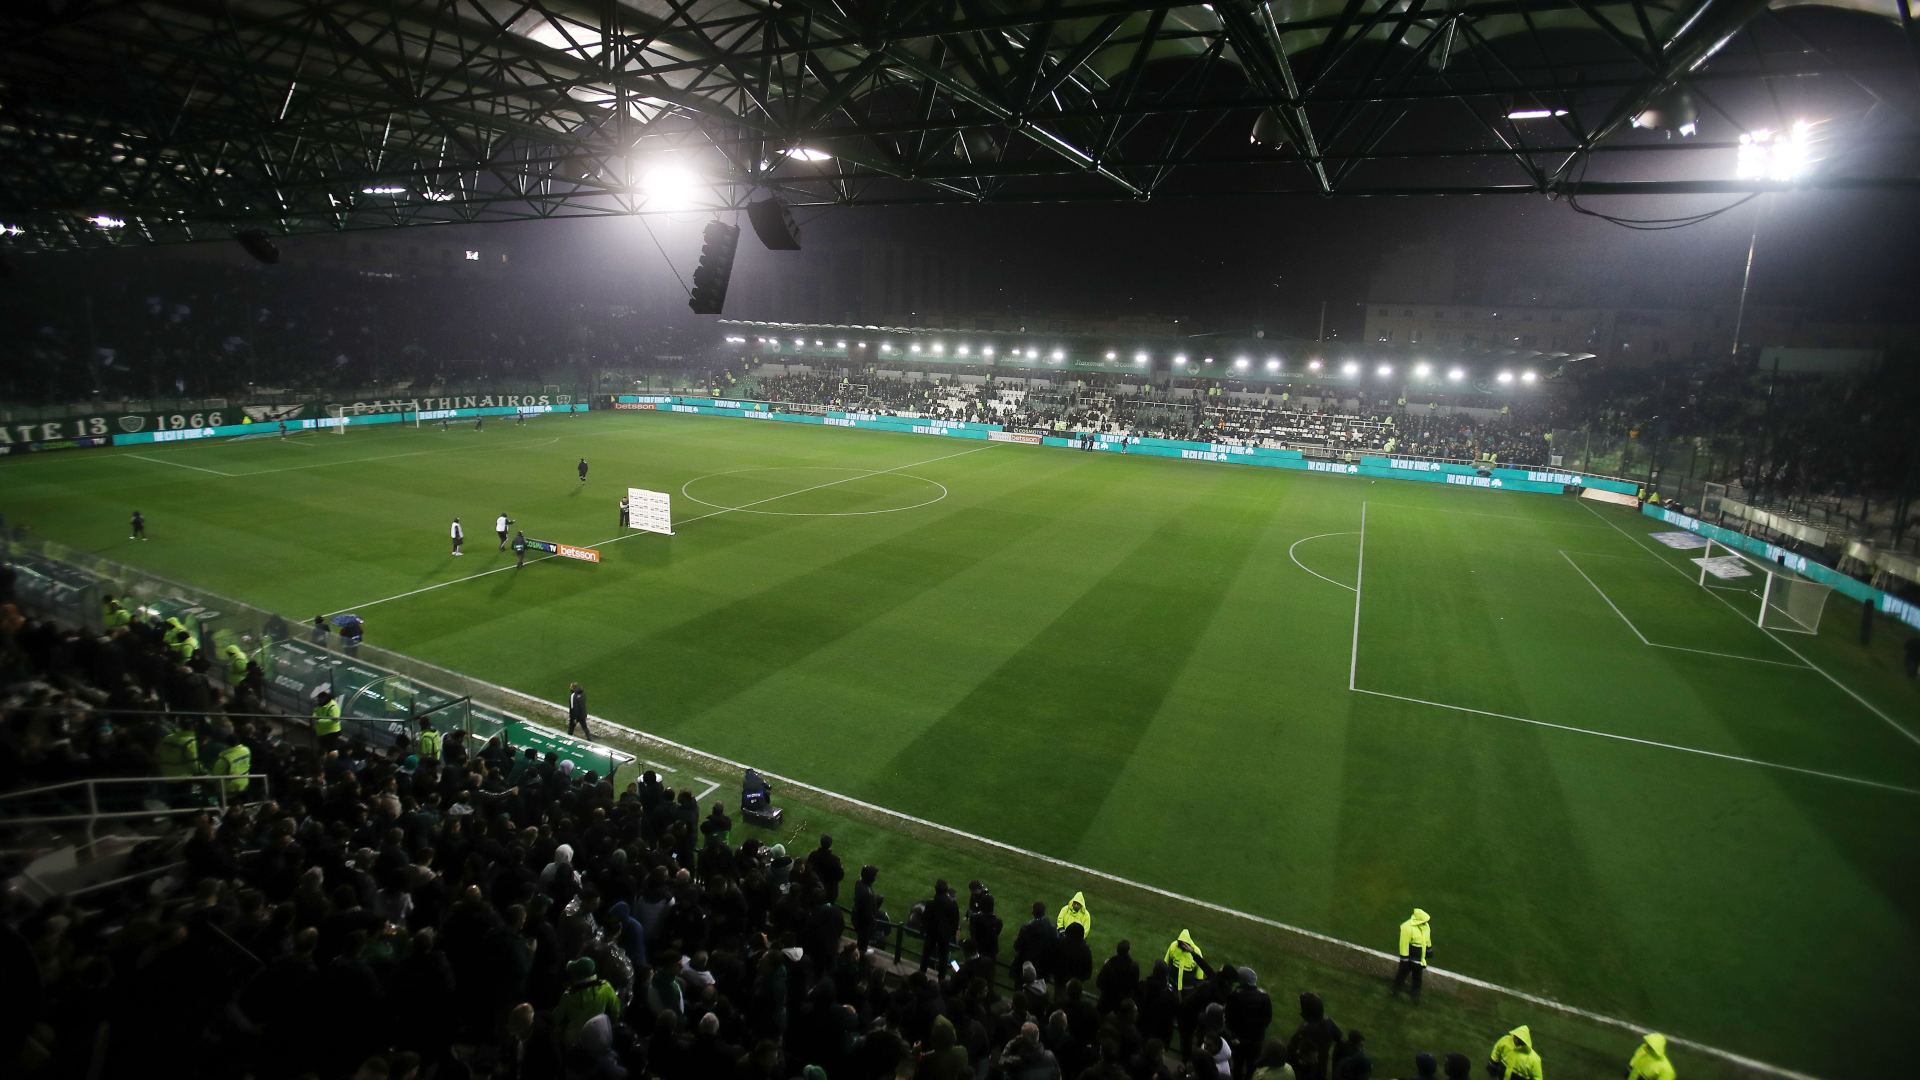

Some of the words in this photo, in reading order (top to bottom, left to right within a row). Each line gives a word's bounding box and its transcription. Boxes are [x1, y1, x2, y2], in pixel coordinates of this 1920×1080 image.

[615, 402, 655, 410] betsson
[76, 417, 108, 437] 13
[156, 412, 222, 430] 1966
[549, 545, 557, 553] TV
[560, 545, 596, 561] betsson
